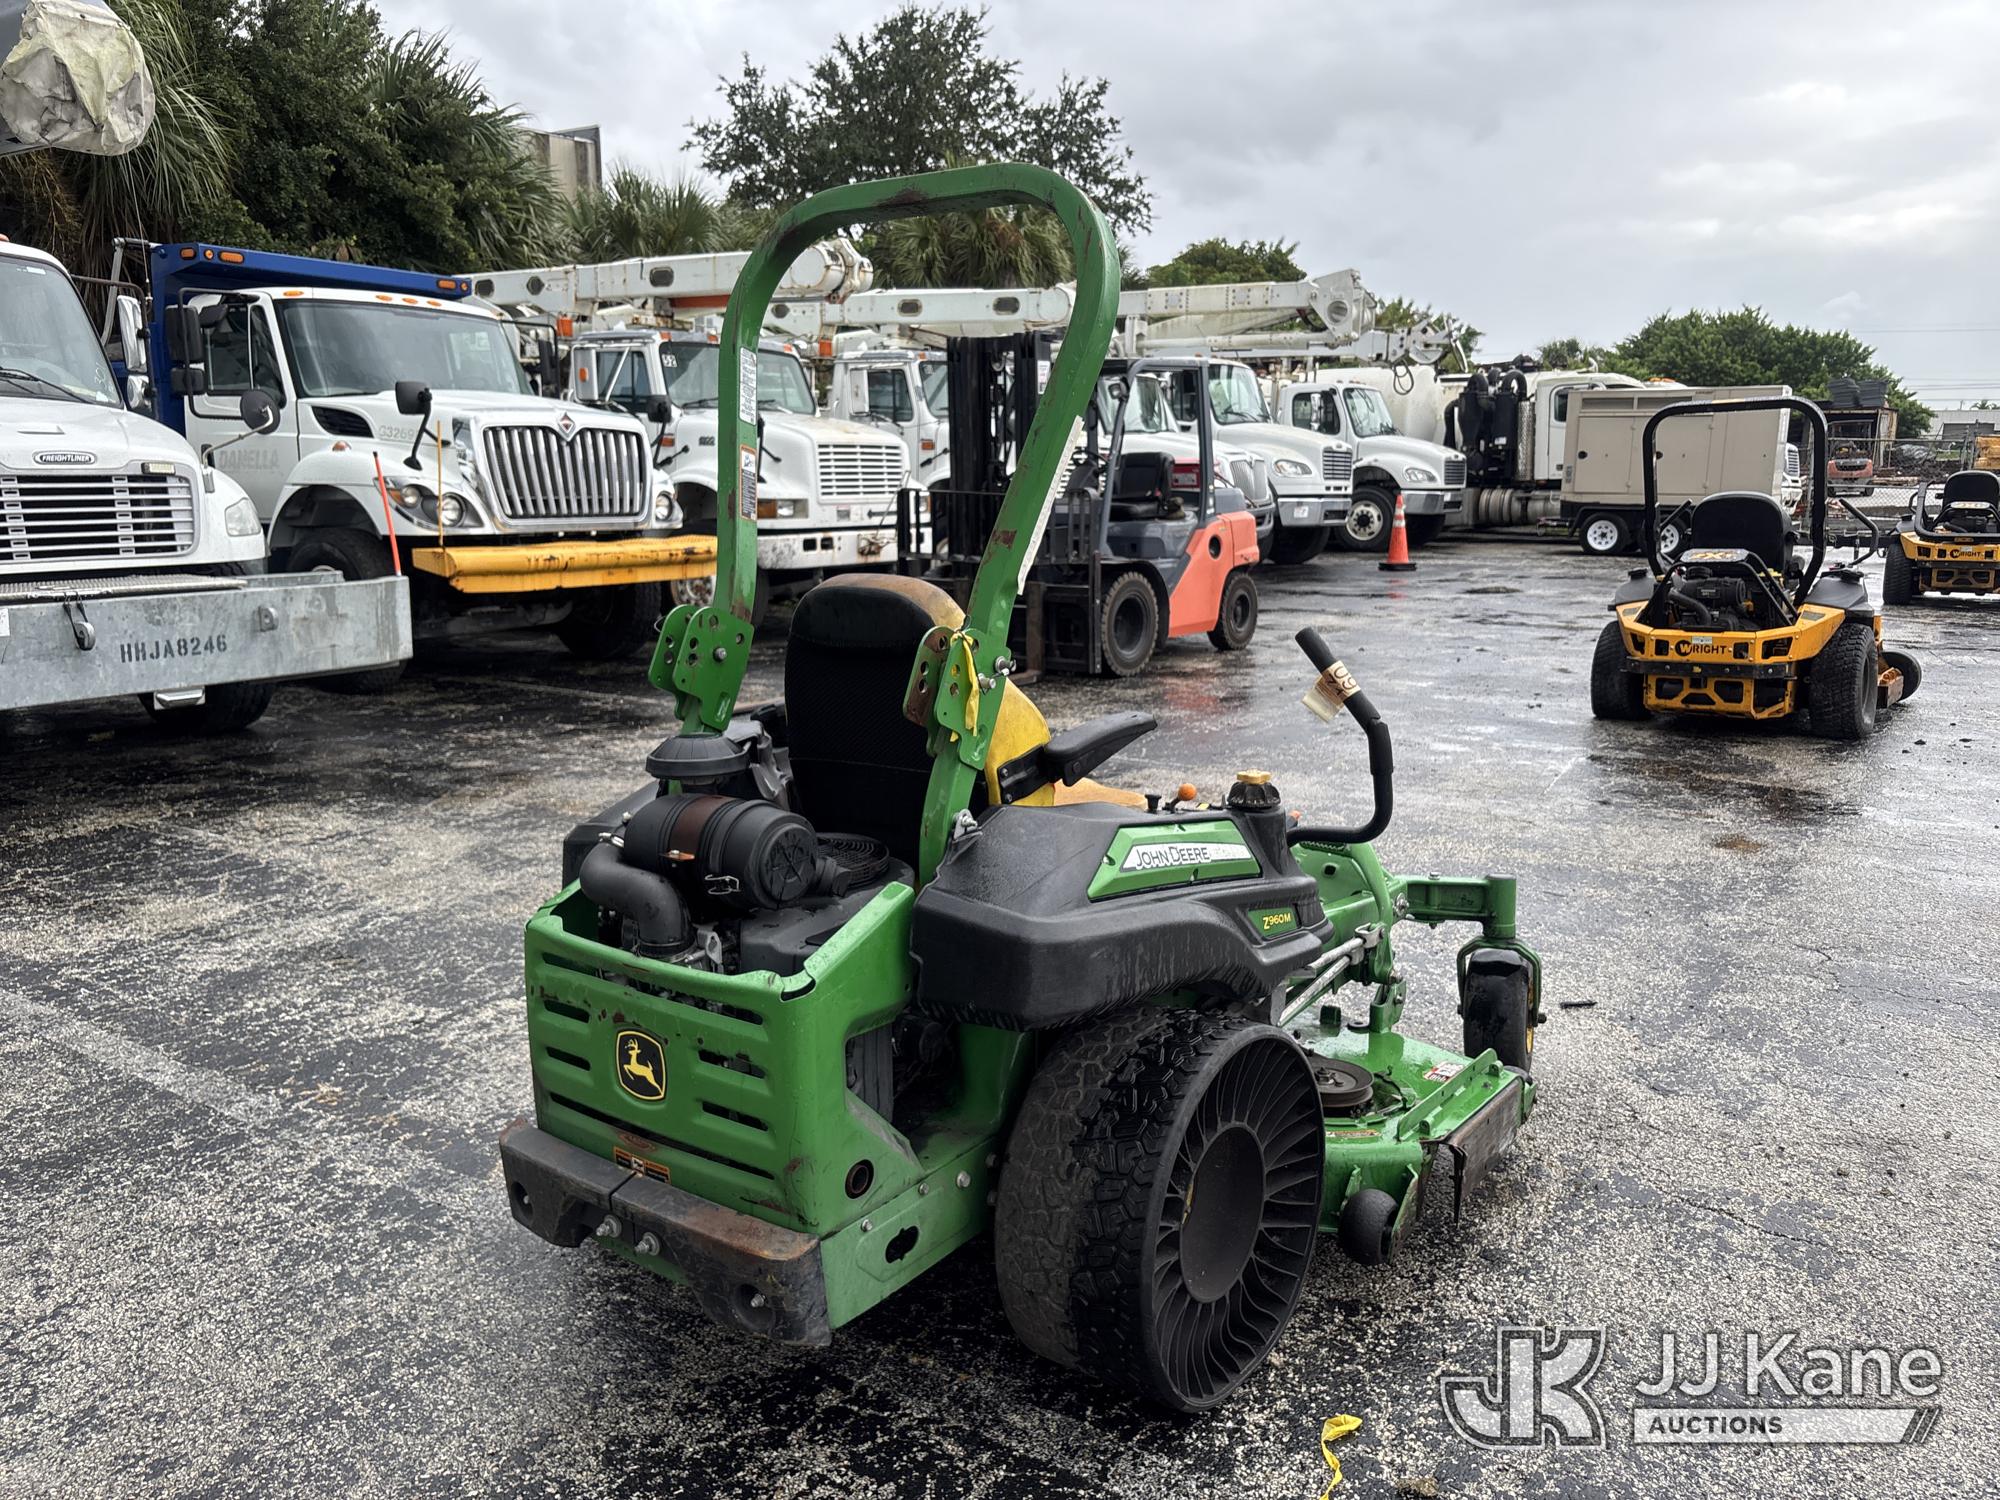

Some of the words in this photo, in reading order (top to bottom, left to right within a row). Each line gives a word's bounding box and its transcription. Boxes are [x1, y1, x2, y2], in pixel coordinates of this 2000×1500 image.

[42, 454, 90, 463] FREIGHTLINER
[120, 634, 227, 663] HHJA8246
[1675, 640, 1727, 656] WRIGHT
[1136, 848, 1169, 867] JOHN
[1168, 846, 1210, 863] DEERE
[1263, 913, 1291, 929] Z960M
